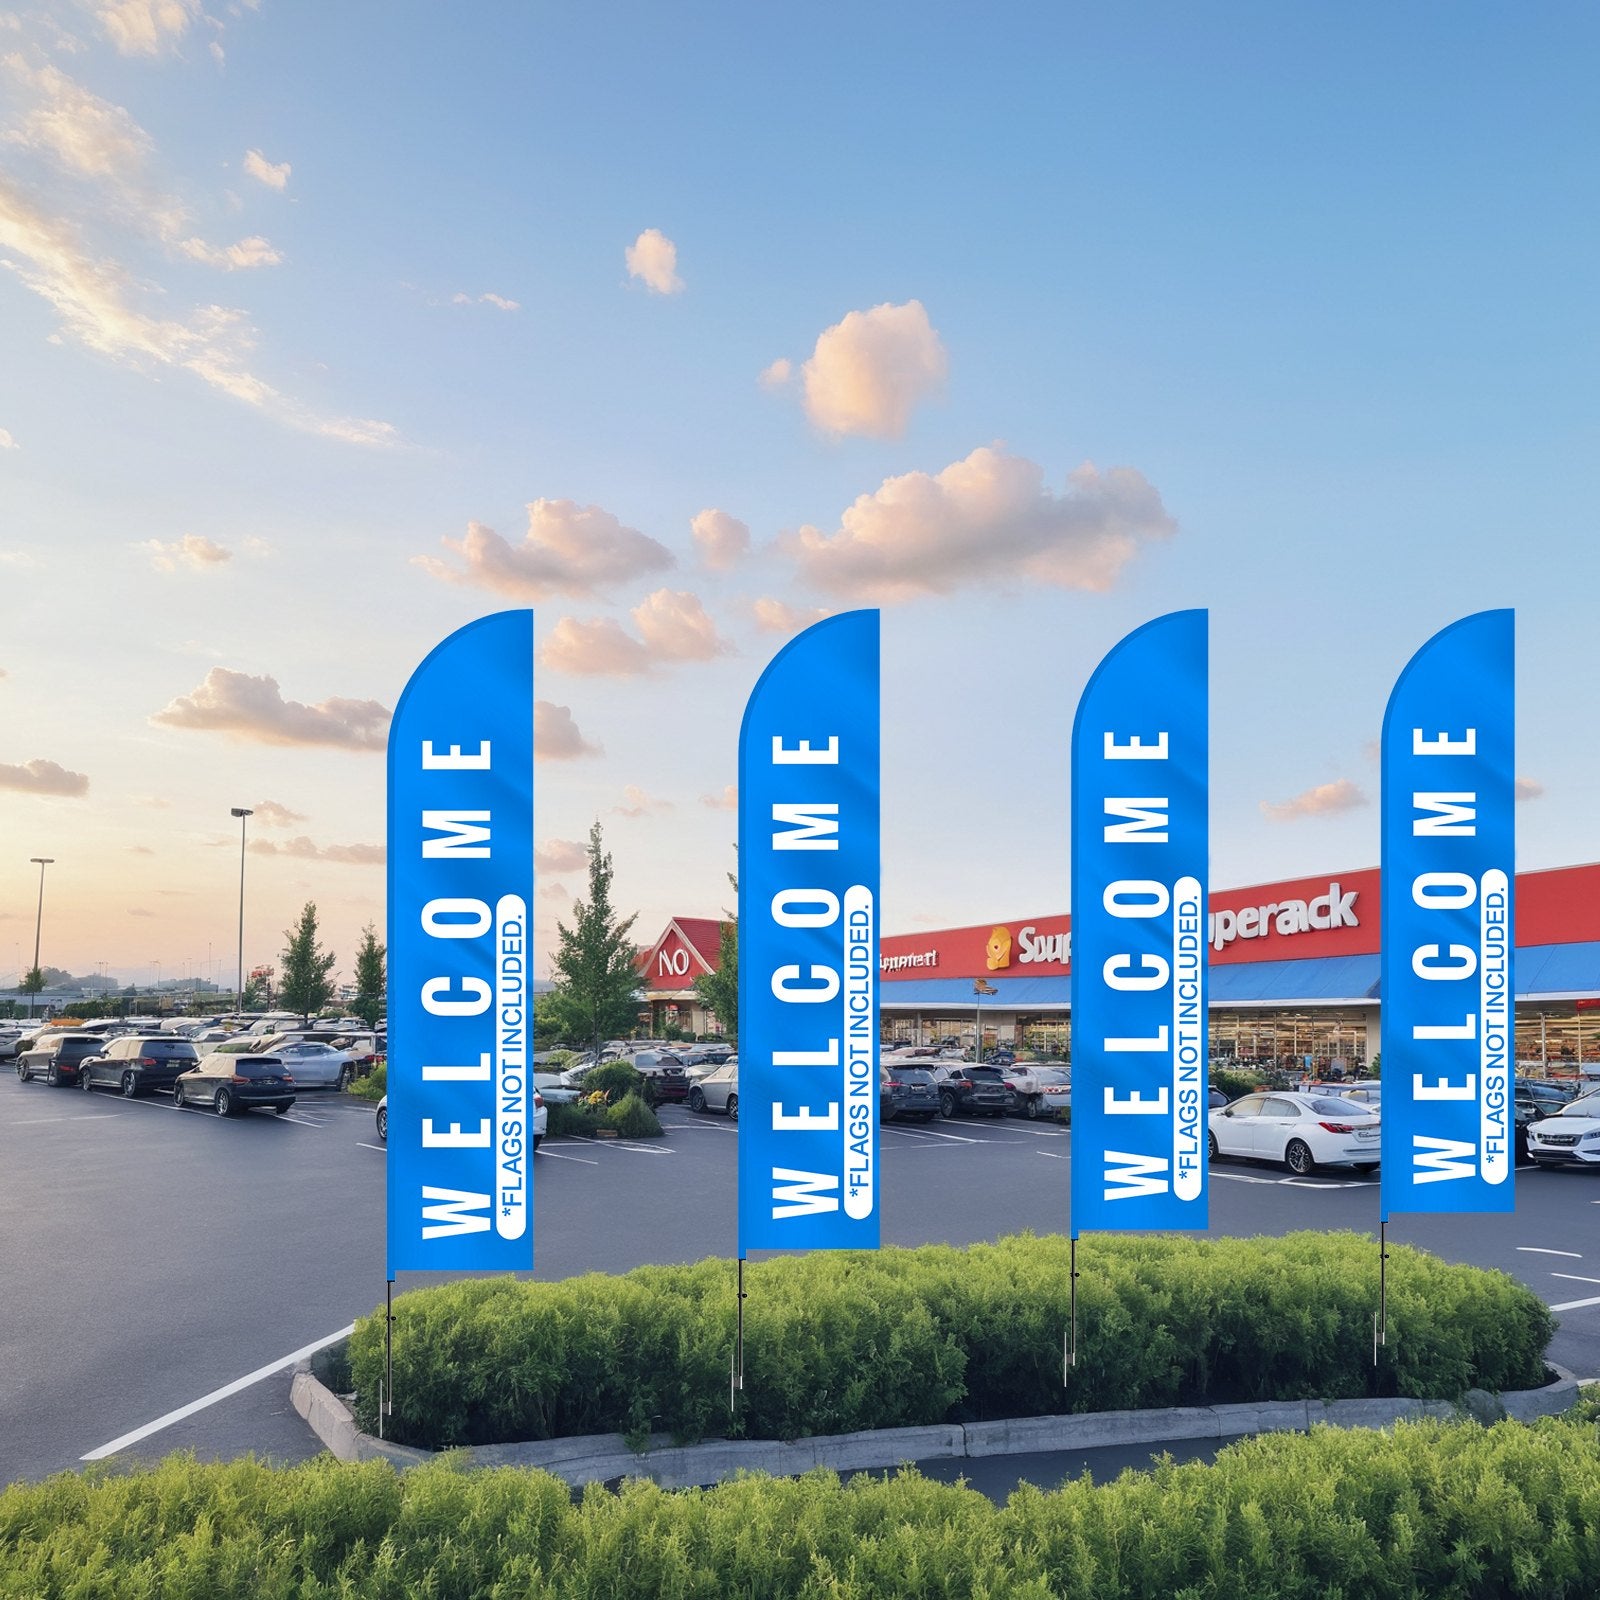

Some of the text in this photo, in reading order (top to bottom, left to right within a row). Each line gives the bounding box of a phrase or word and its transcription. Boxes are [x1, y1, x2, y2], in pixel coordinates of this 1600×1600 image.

[422, 741, 491, 1238] WELCOME
[658, 948, 690, 977] NO
[772, 737, 839, 1218] WELCOME
[1104, 733, 1169, 1200] WELCOME
[1413, 729, 1476, 1183] WELCOME
